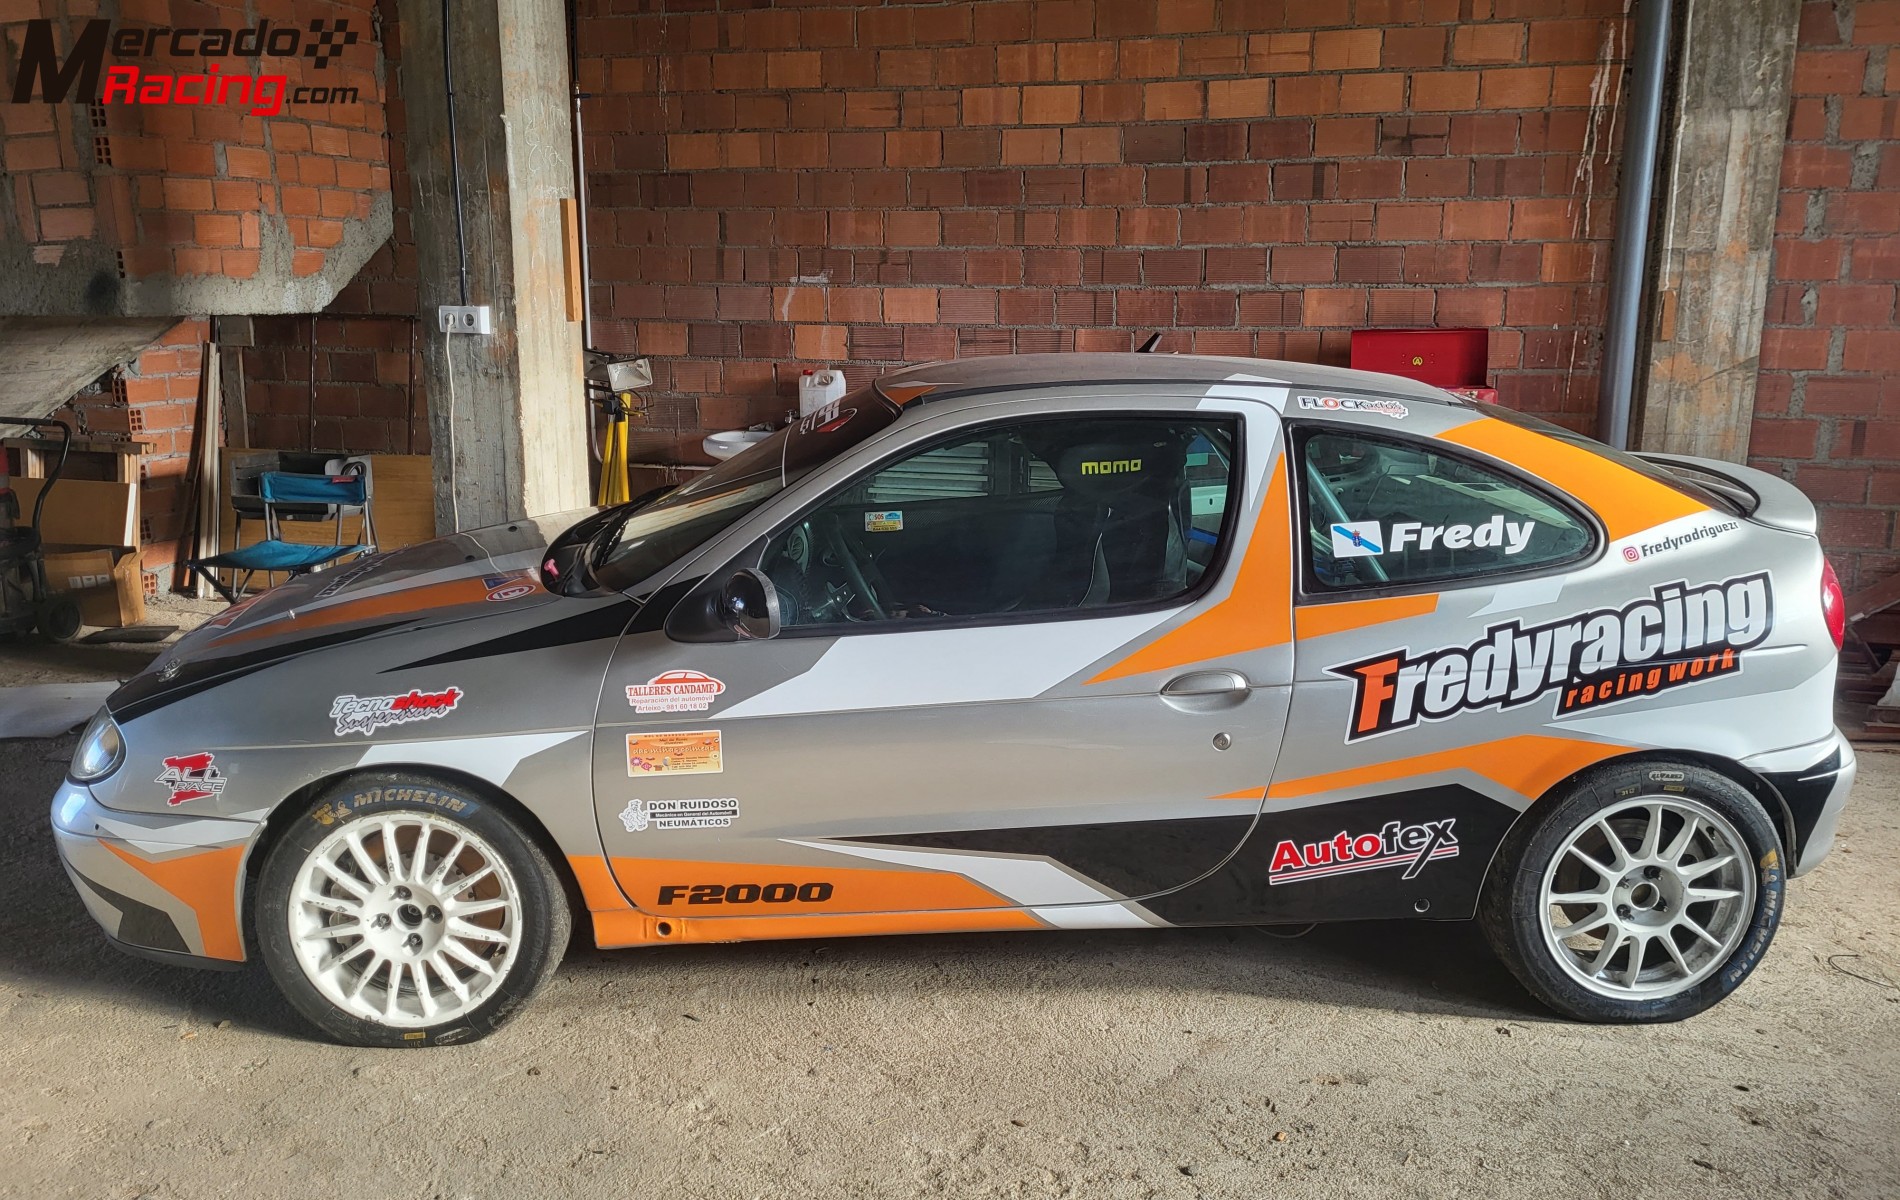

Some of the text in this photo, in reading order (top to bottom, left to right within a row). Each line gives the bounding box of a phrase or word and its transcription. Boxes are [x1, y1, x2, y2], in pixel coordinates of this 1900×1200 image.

[1081, 458, 1142, 475] momo
[1389, 514, 1536, 555] Fredy
[1353, 576, 1769, 734] Fredyracing
[1565, 648, 1736, 708] racing work
[628, 683, 715, 697] TALLERES CANDAME
[631, 693, 713, 704] Reparación del automóvil
[331, 688, 460, 716] Tecnoshock
[637, 704, 661, 712] Arteixo
[155, 766, 227, 783] ALL
[174, 780, 224, 793] RACE
[353, 787, 467, 814] MICHELIN
[649, 799, 737, 811] DON RUIDOSO
[659, 817, 730, 828] NEUMÁTICOS
[1269, 818, 1459, 880] Autofex
[657, 882, 834, 906] F2000
